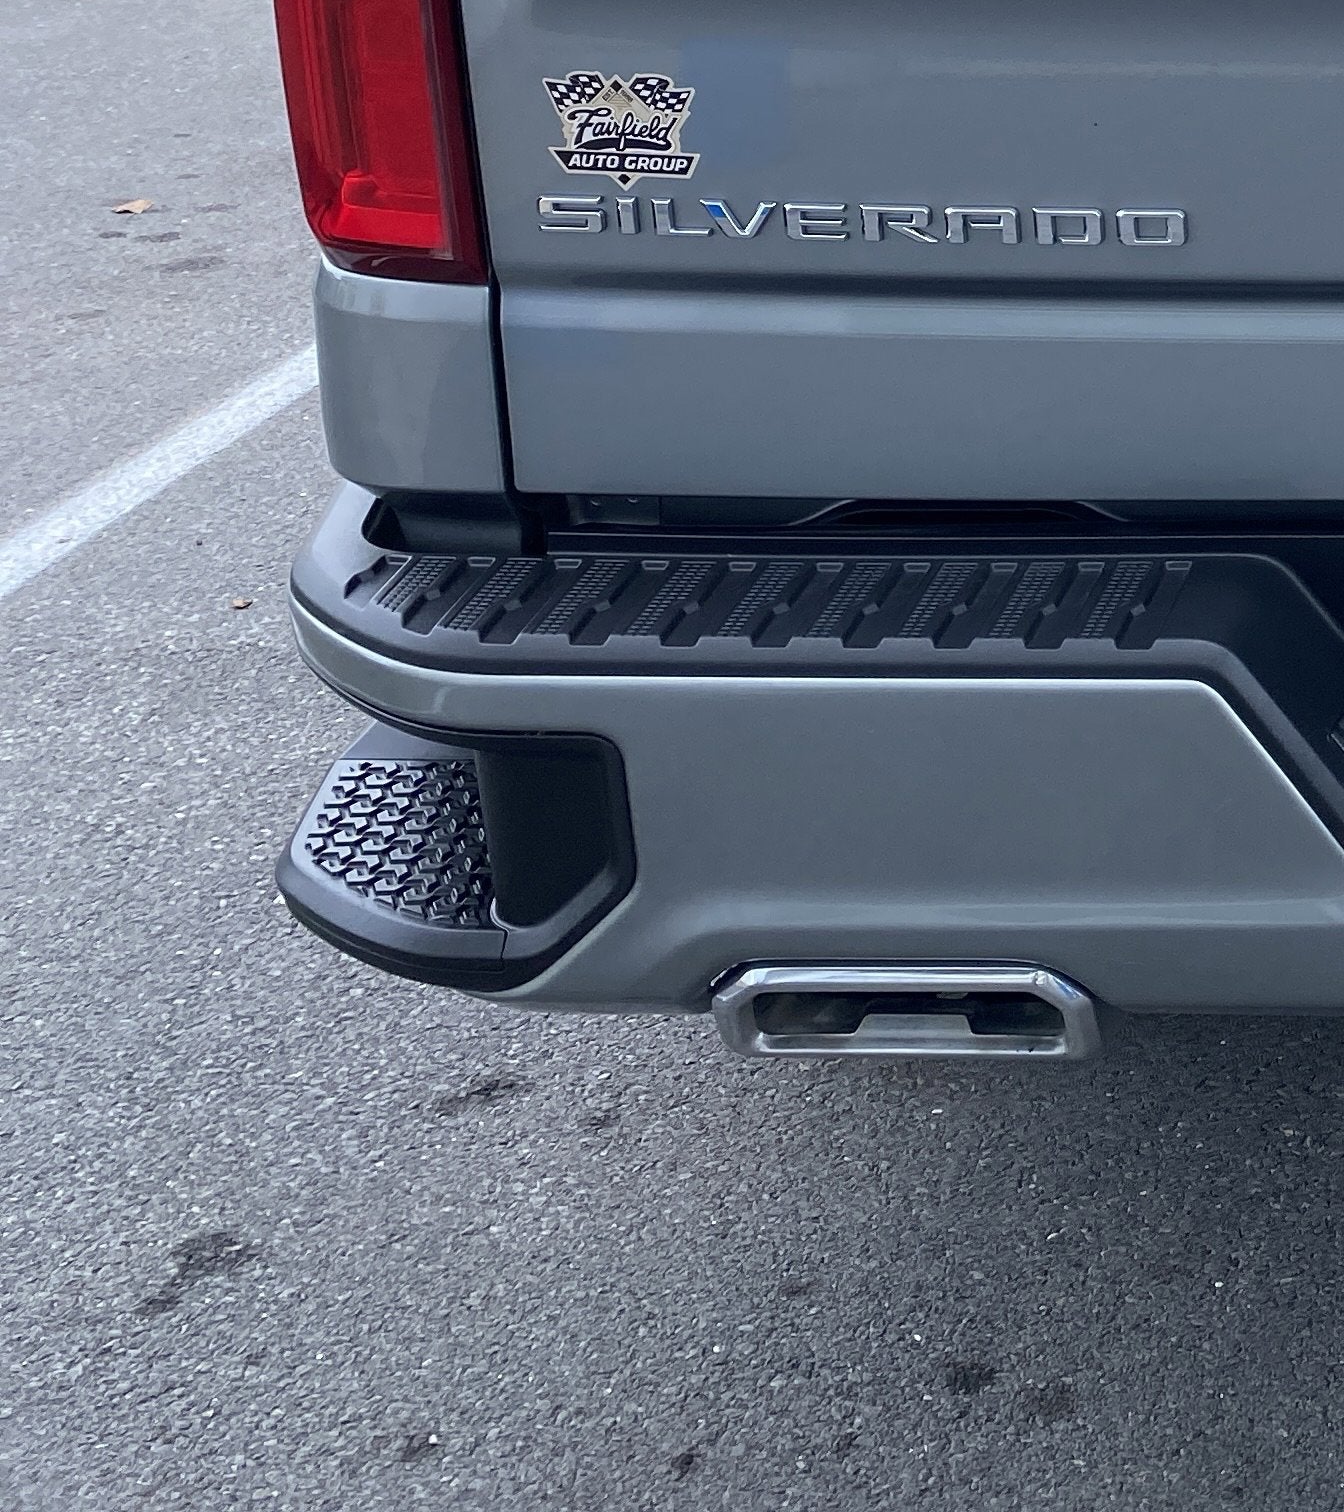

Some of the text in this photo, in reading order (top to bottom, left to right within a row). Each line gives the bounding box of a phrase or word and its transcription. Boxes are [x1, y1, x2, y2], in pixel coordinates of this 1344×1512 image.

[567, 107, 679, 148] Fairfield
[568, 153, 688, 172] AUTO GROUP
[537, 195, 1188, 247] SILVERADO
